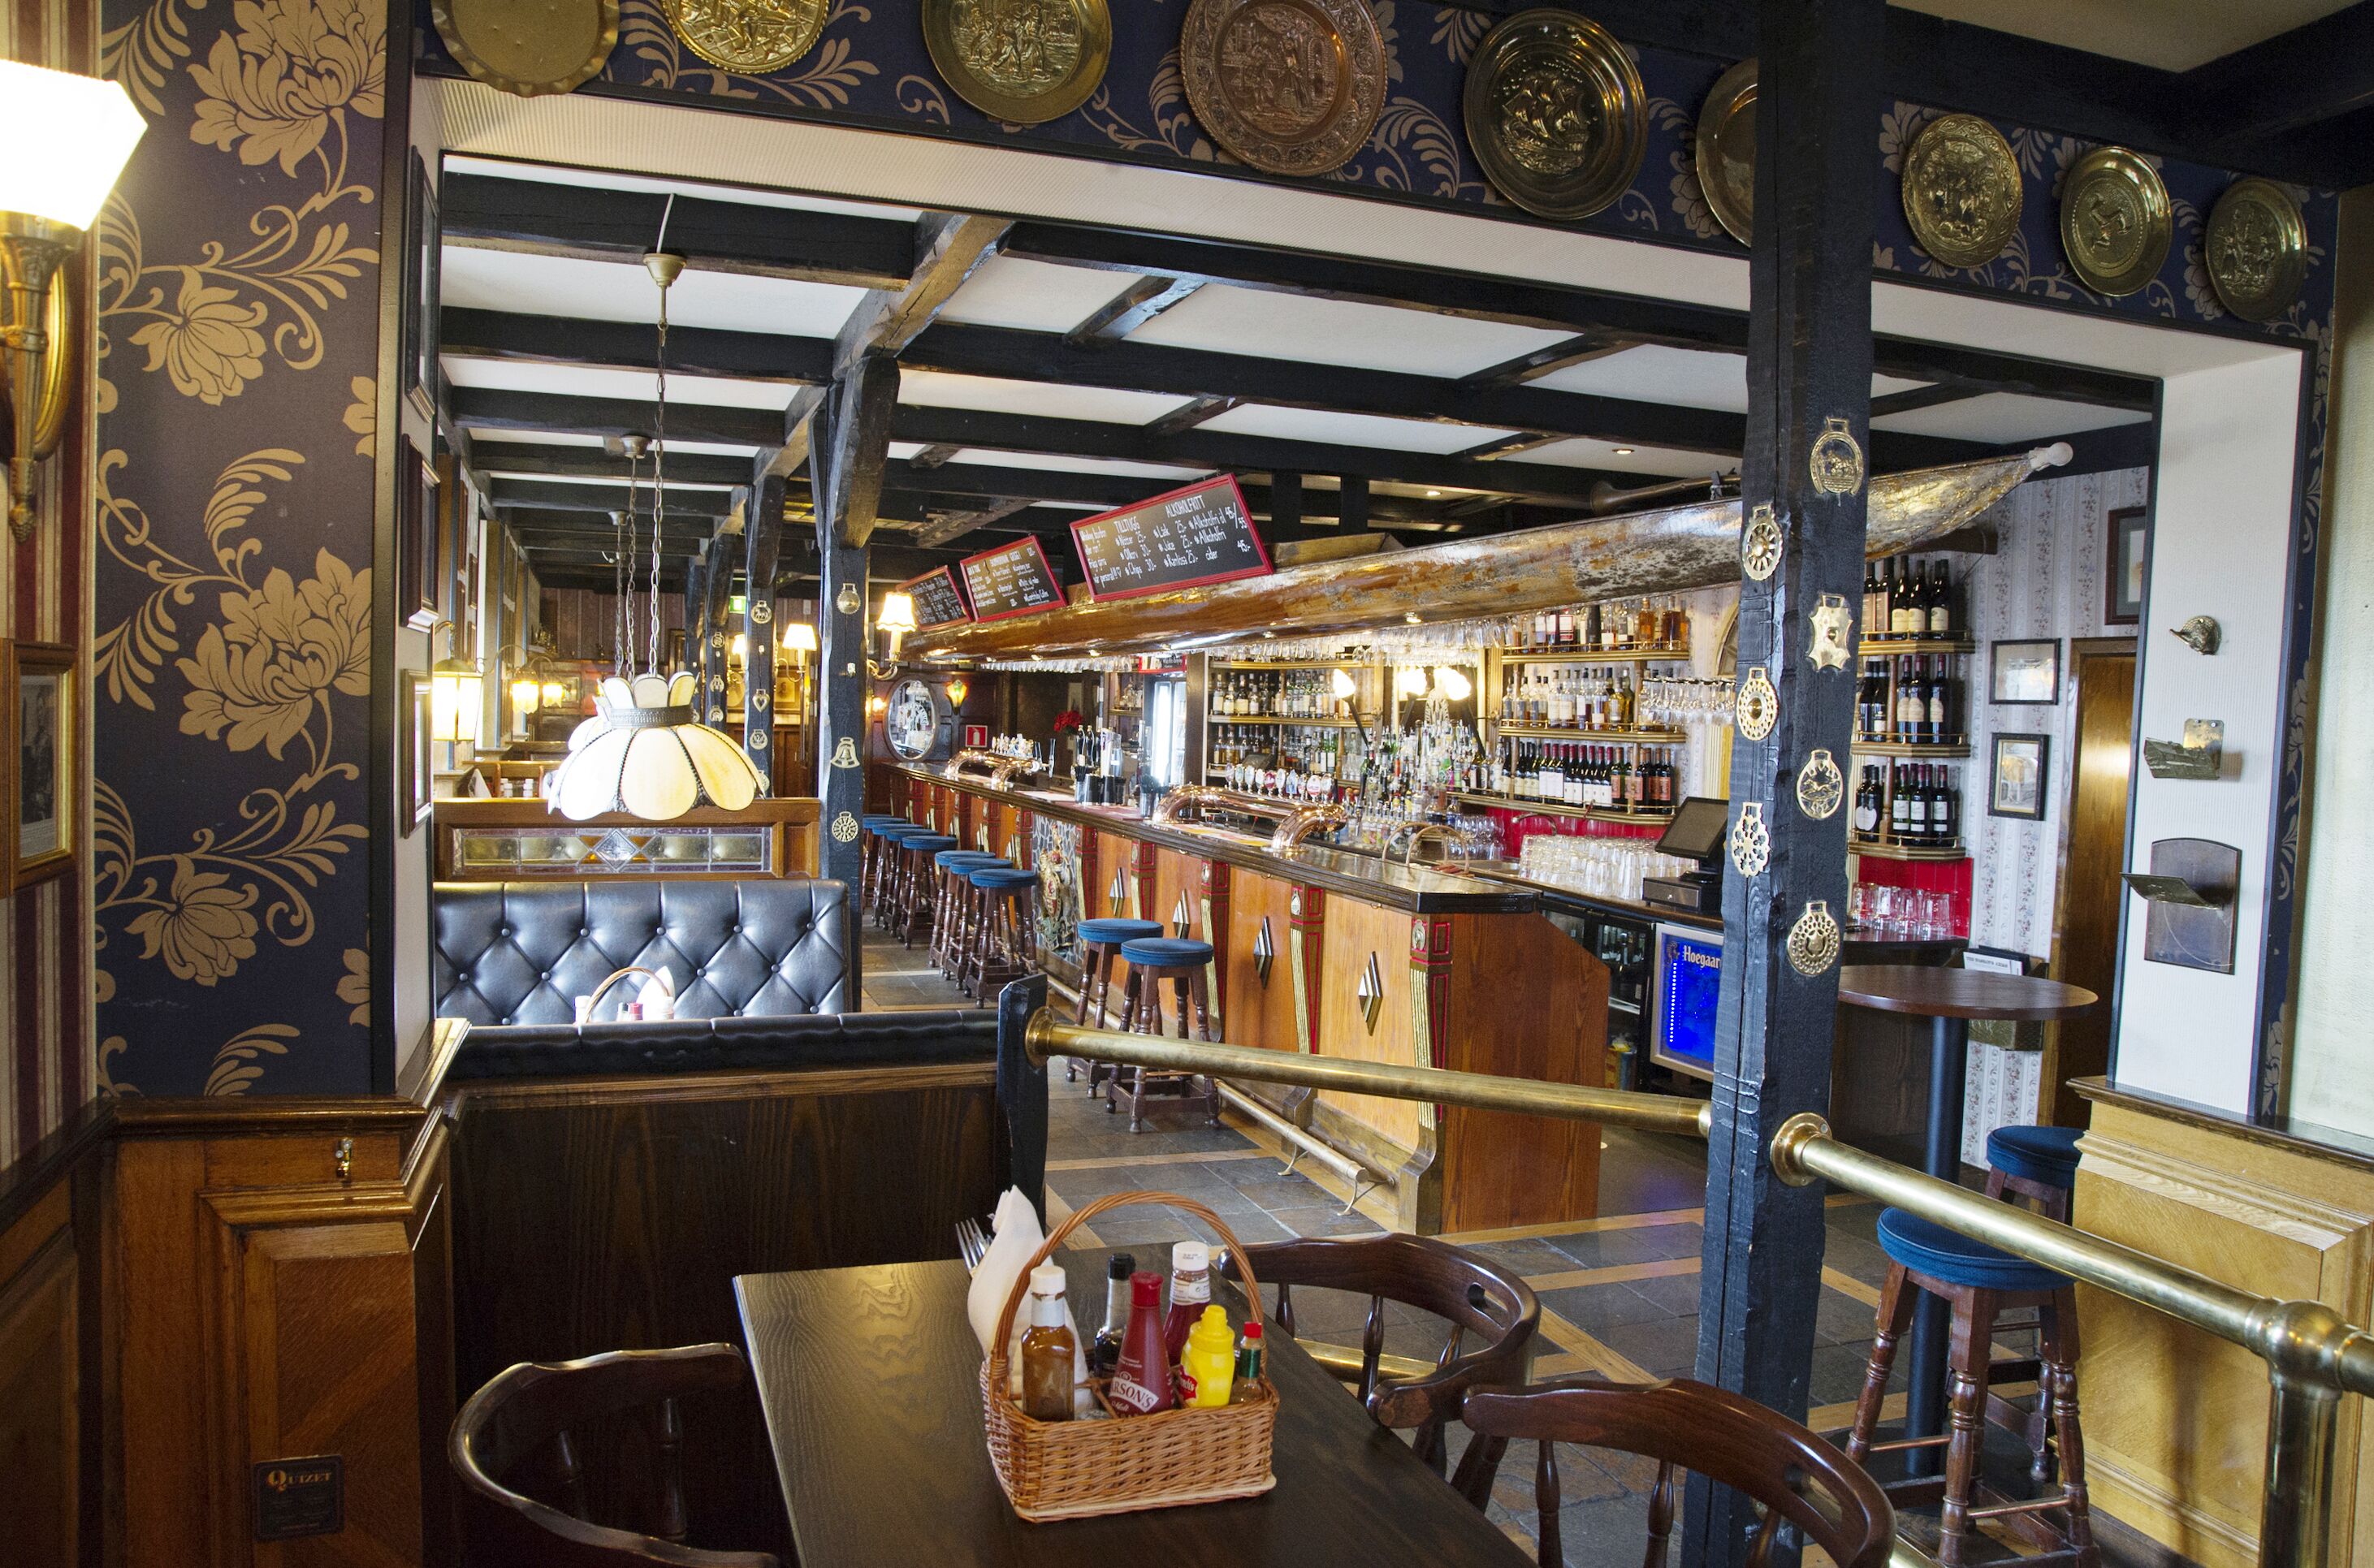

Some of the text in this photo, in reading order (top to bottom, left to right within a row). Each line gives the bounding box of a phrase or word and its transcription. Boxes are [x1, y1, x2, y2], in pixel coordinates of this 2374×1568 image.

[1165, 495, 1205, 518] ALKOHOLFRITT
[1113, 516, 1140, 533] TILLTUGG
[1192, 510, 1220, 529] Alkoholfri
[1157, 524, 1170, 538] Läsk
[1198, 525, 1227, 545] Alkoholfri
[1205, 546, 1218, 561] cider
[1128, 562, 1143, 579] Chips
[1684, 945, 1722, 970] Hoegaar
